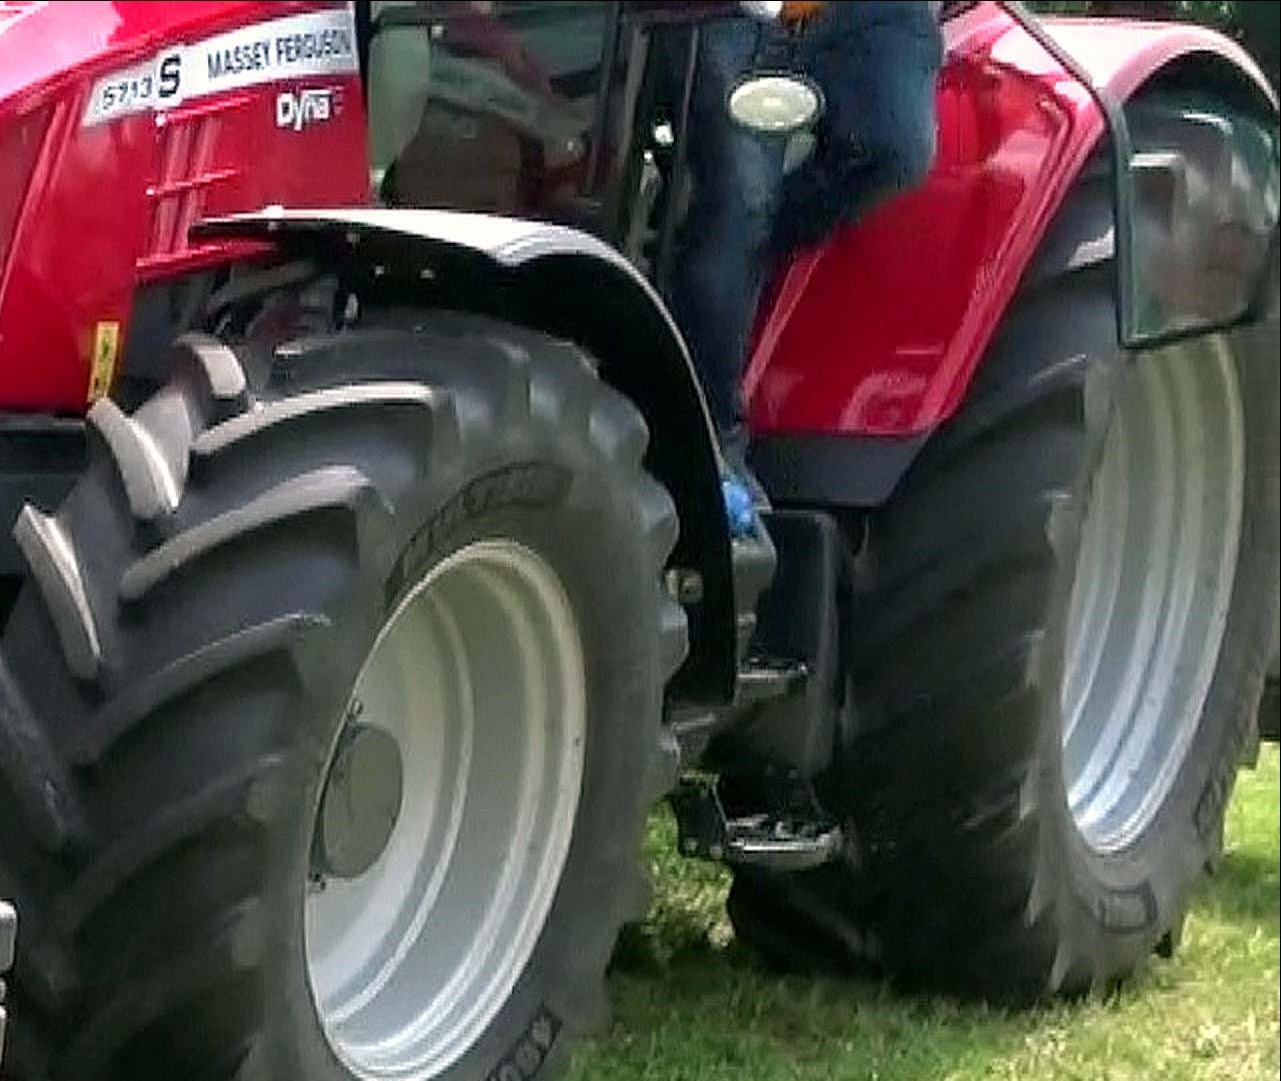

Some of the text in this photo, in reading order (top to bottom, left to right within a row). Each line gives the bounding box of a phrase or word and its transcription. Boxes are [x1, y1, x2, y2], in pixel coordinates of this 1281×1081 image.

[207, 28, 350, 80] MASSEY FERGUSON
[102, 53, 182, 110] 5713 S
